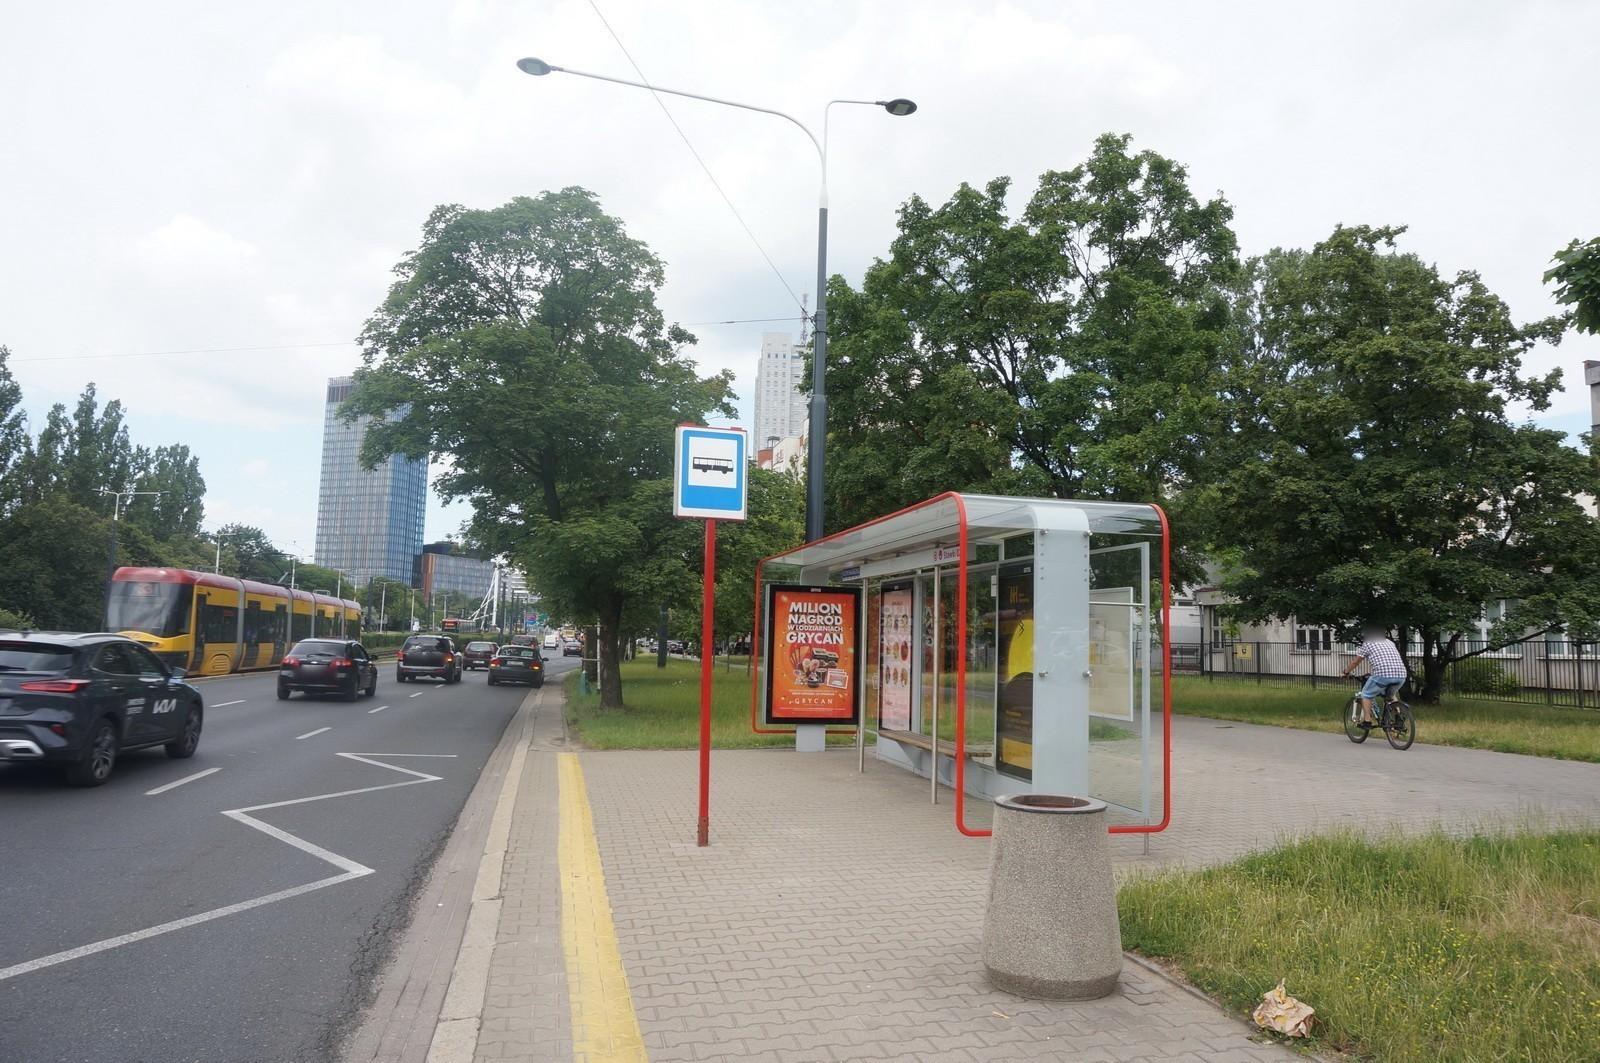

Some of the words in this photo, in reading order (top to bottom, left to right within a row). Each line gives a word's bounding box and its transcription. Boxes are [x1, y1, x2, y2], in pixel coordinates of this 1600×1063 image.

[789, 602, 842, 614] MILION
[788, 612, 843, 625] NAGRÓD
[786, 632, 844, 645] GRYCAN
[152, 699, 177, 714] KIA
[794, 697, 833, 705] GRYCAN
